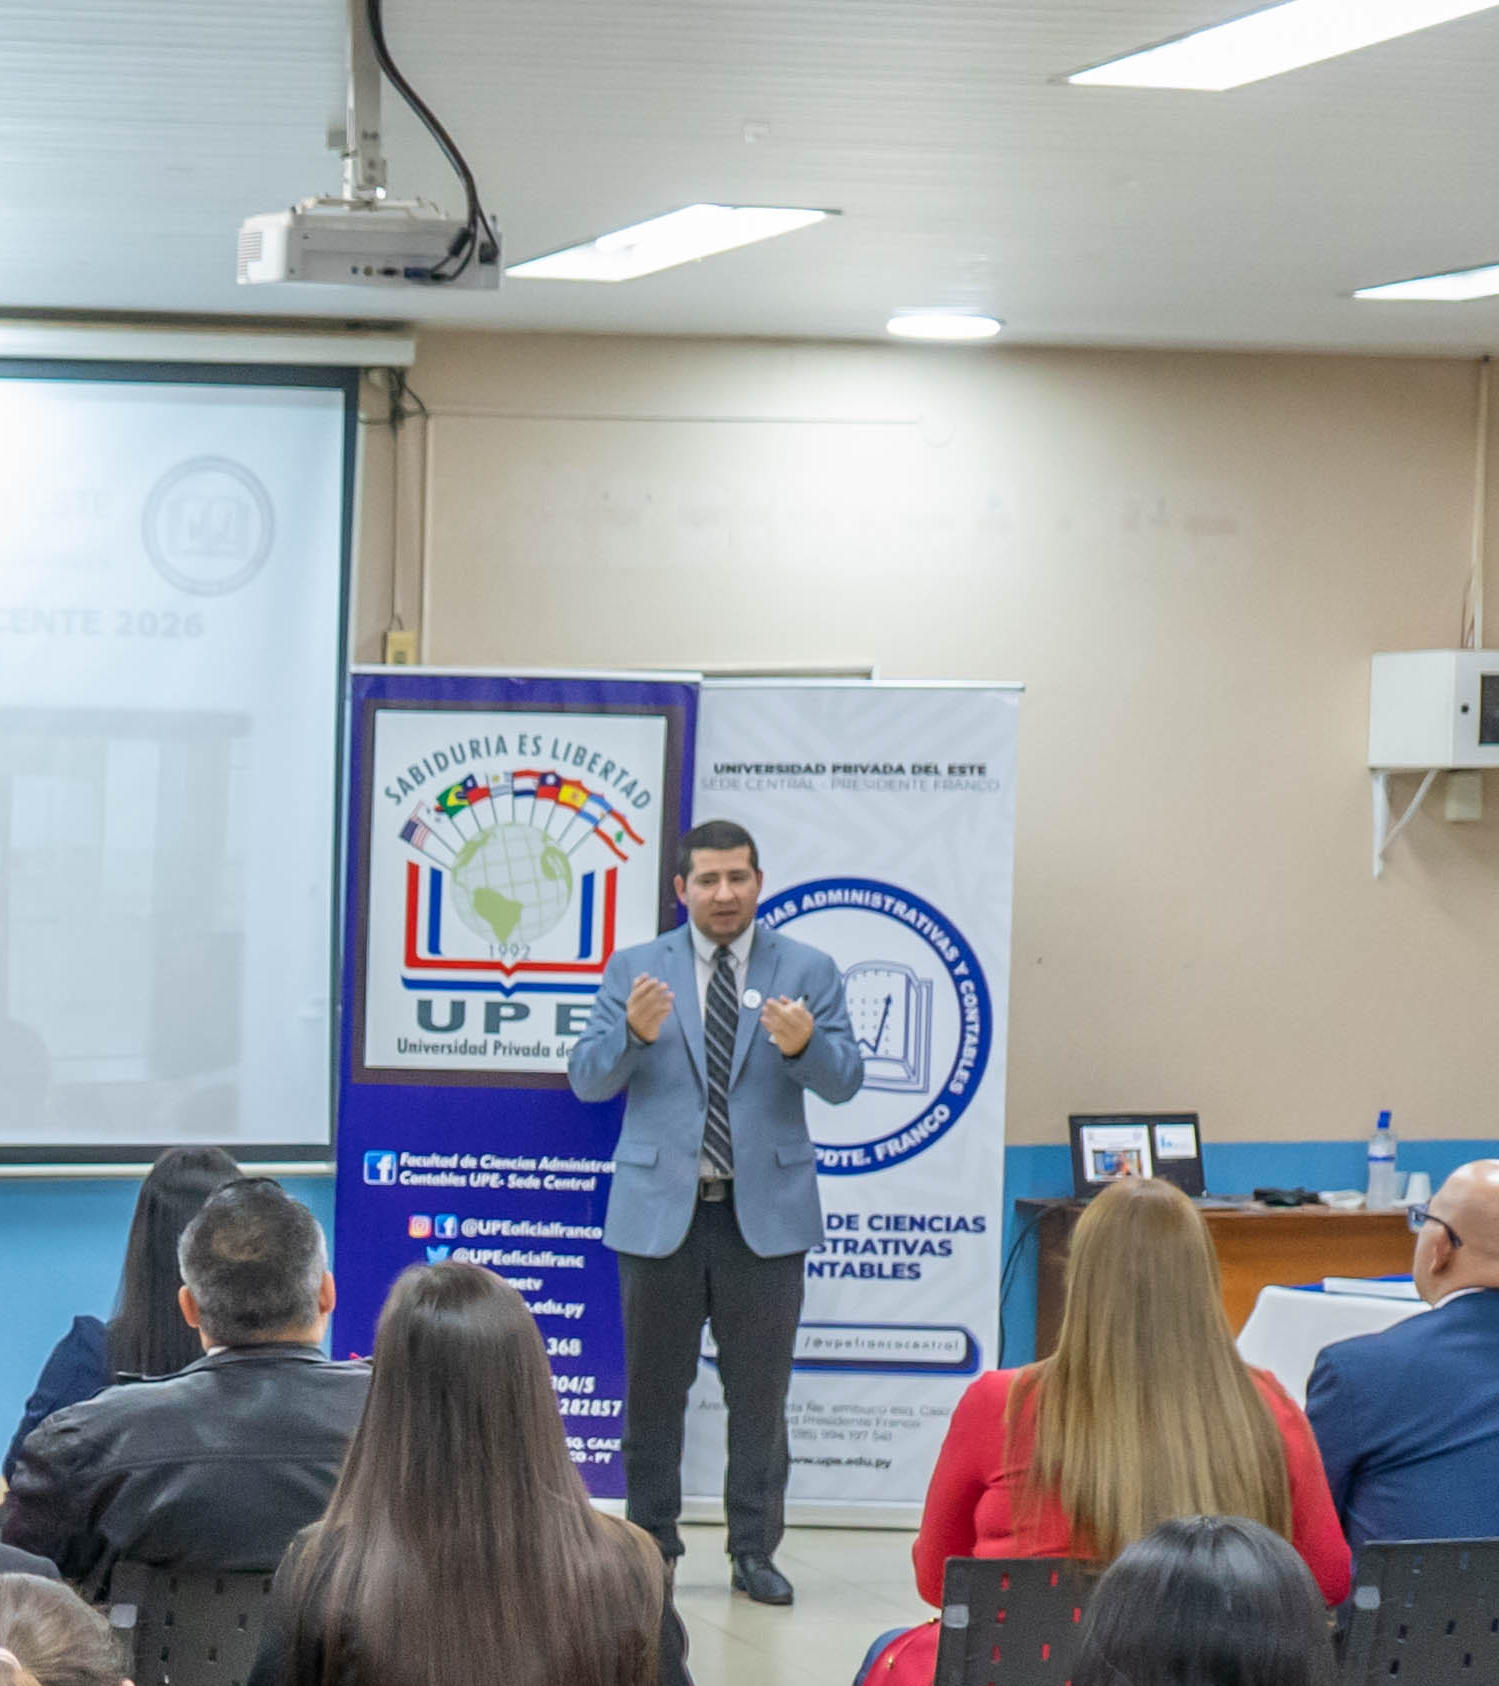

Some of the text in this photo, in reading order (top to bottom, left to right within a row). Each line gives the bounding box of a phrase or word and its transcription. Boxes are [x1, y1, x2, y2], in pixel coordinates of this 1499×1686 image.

[114, 609, 206, 639] 2026
[384, 734, 652, 810] SABIDURIA ES LIBERTAD
[713, 762, 987, 778] UNIVERSIDAD PRIVADA DEL ESTE
[701, 777, 746, 792] SEDE
[752, 777, 816, 792] CENTRAL
[830, 778, 926, 793] PRESIDENTE
[932, 779, 1001, 793] FRANCO
[487, 943, 532, 962] 1992
[802, 888, 980, 1096] ADMINISTRATIVAS Y CONTABLES
[416, 998, 591, 1038] UPE
[397, 1037, 573, 1059] Universidad Privada de
[874, 1103, 951, 1162] FRANCO
[399, 1151, 616, 1174] Facultad de Ciencias Administrat
[399, 1171, 467, 1188] Contables
[507, 1174, 541, 1190] Sede
[543, 1176, 596, 1191] Central
[460, 1218, 603, 1241] @UPEoficialfranco
[827, 1213, 986, 1233] DE CIENCIAS
[814, 1236, 953, 1257] STRATIVAS
[807, 1262, 922, 1281] NTABLES
[525, 1299, 585, 1319] .edu.py
